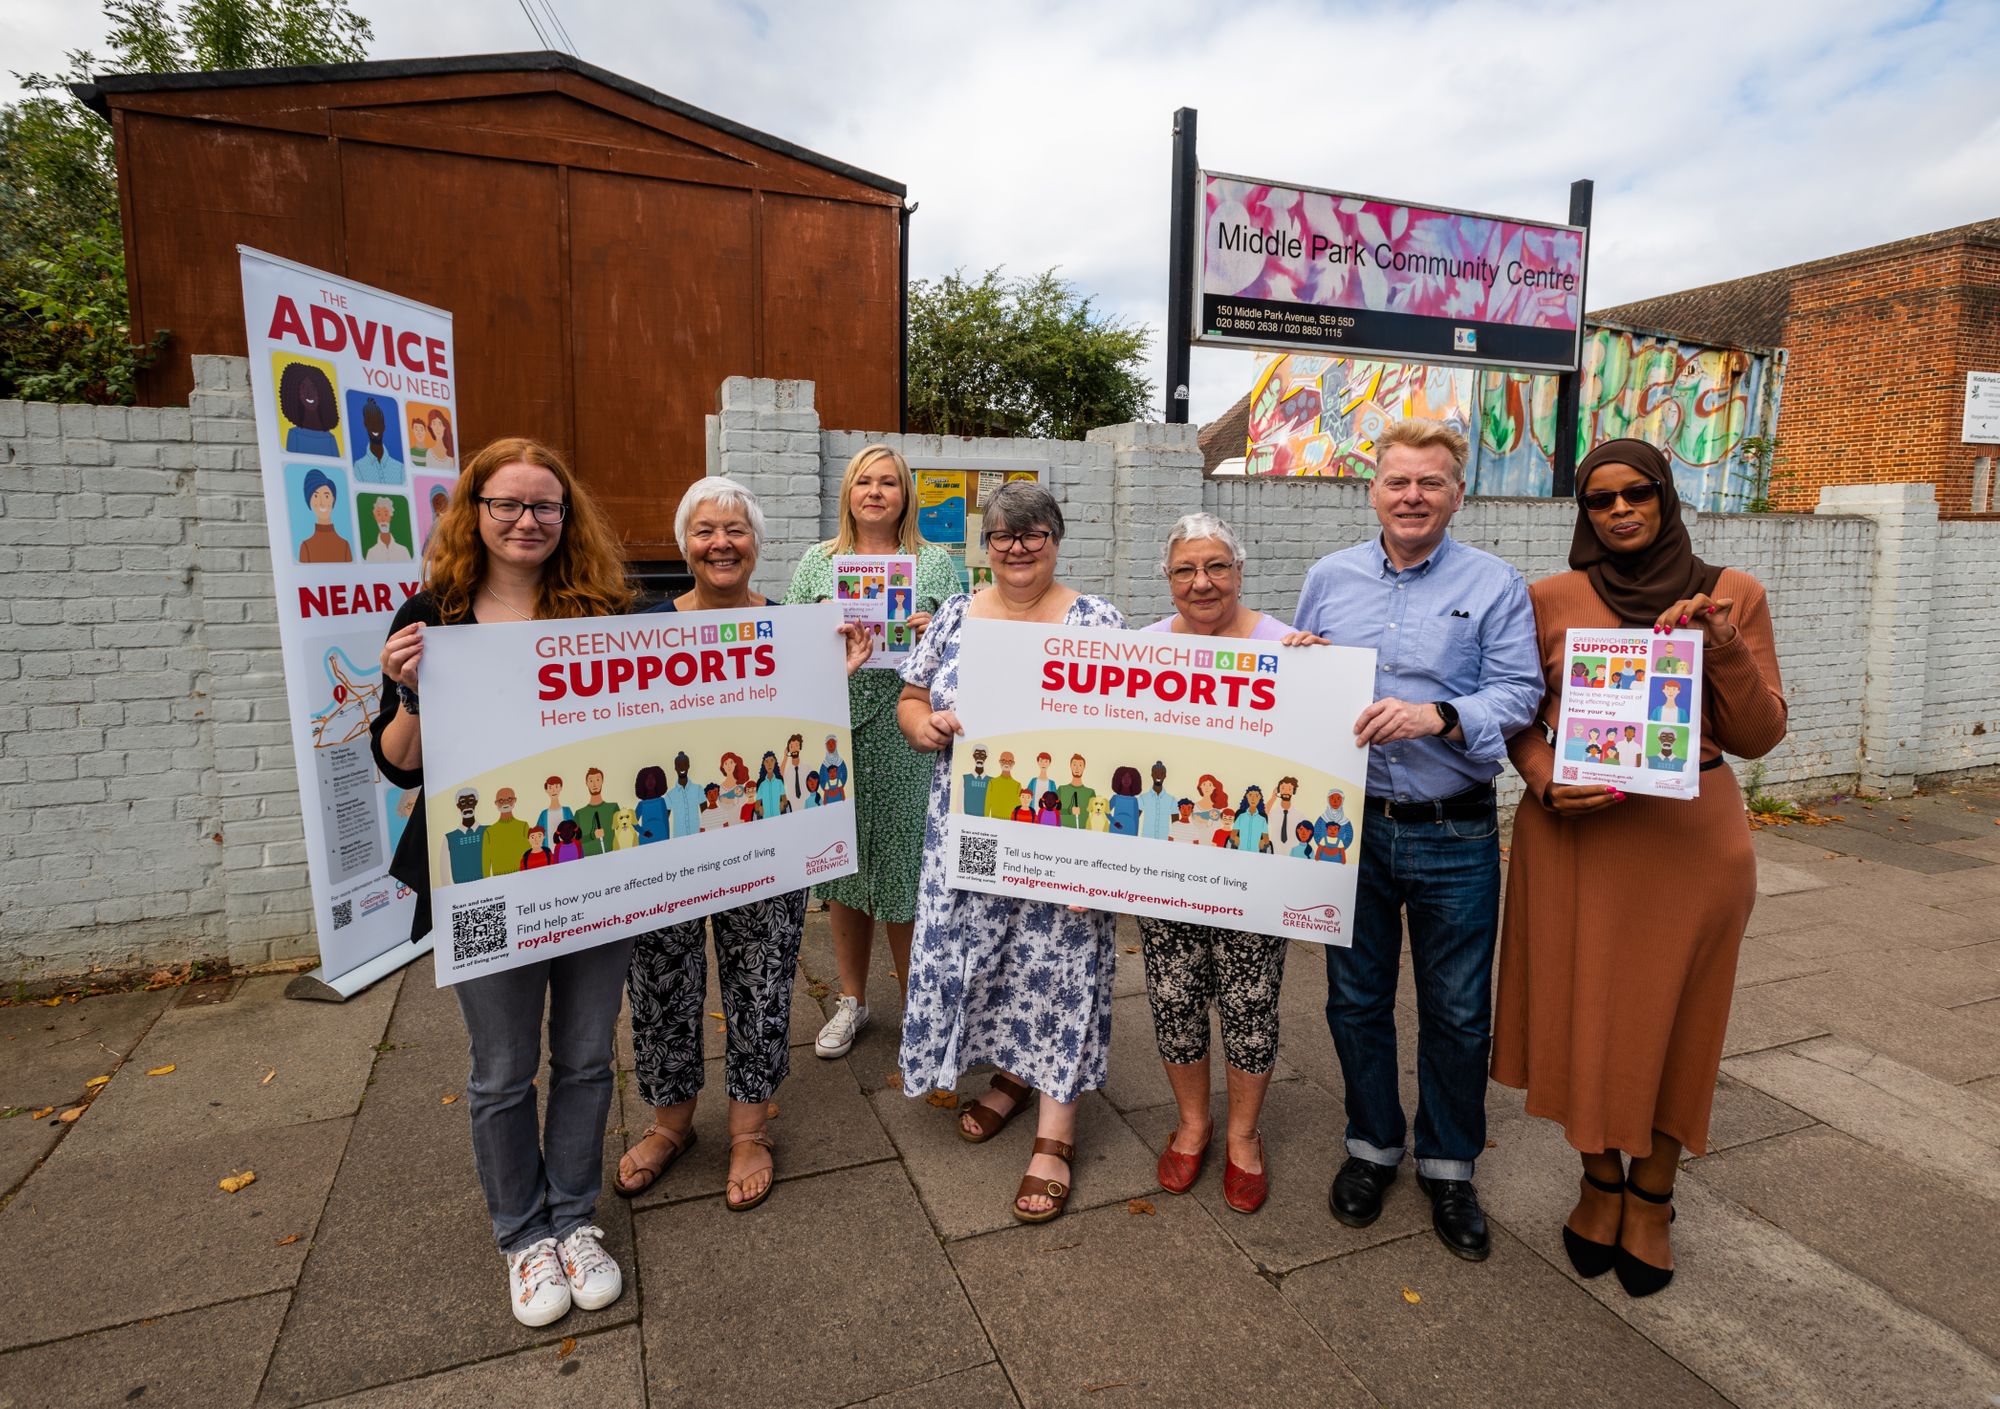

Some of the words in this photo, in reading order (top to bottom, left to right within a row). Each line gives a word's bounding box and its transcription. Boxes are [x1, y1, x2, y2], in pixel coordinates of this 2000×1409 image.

[1218, 222, 1302, 259] Middle
[1311, 235, 1365, 267] Park
[1374, 243, 1500, 288] Community
[1506, 260, 1575, 292] Centre
[320, 289, 348, 310] THE
[1215, 317, 1233, 329] 020
[1234, 318, 1256, 330] 8850
[1257, 320, 1278, 332] 2638
[1284, 322, 1301, 334] 020
[1302, 323, 1323, 335] 8850
[1324, 326, 1342, 338] 1115
[1216, 305, 1233, 317] 150
[1234, 306, 1263, 320] Middle
[1264, 309, 1284, 321] Park
[1284, 312, 1317, 325] Avenue,
[1319, 315, 1336, 326] SE9
[1337, 316, 1356, 328] 5SD
[268, 294, 449, 379] ADVICE
[362, 366, 402, 391] YOU
[406, 376, 451, 401] NEED
[298, 583, 394, 618] NEAR
[535, 627, 697, 659] GREENWICH
[1044, 638, 1191, 667] GREENWICH
[1573, 636, 1621, 644] GREENWICH
[1573, 643, 1648, 655] SUPPORTS
[538, 644, 776, 701] SUPPORTS
[1041, 660, 1276, 711] SUPPORTS
[541, 709, 586, 727] Here
[593, 707, 611, 720] to
[617, 701, 664, 718] listen,
[670, 694, 715, 711] advise
[720, 687, 744, 704] and
[750, 684, 777, 702] help
[1585, 699, 1610, 707] affecting
[1041, 697, 1078, 714] Here
[1083, 704, 1099, 716] to
[1105, 703, 1148, 723] listen,
[1154, 709, 1200, 726] advise
[1207, 715, 1234, 729] and
[1241, 716, 1273, 737] help
[806, 857, 829, 869] ROYAL
[806, 858, 850, 876] GREENWICH
[1003, 862, 1021, 873] Find
[1023, 864, 1043, 877] help
[1044, 869, 1056, 878] at:
[1004, 846, 1020, 857] Tell
[1021, 851, 1031, 859] us
[1033, 851, 1053, 862] how
[1055, 856, 1072, 865] you
[1074, 858, 1089, 867] are
[1091, 859, 1127, 872] affected
[1130, 864, 1141, 875] by
[1143, 866, 1158, 876] the
[1161, 868, 1185, 882] rising
[1187, 873, 1208, 883] cost
[1210, 875, 1222, 885] of
[1223, 876, 1248, 891] living
[516, 902, 536, 916] Tell
[539, 901, 552, 911] us
[555, 895, 579, 907] how
[581, 890, 602, 904] you
[604, 885, 621, 896] are
[624, 873, 663, 891] affected
[666, 871, 677, 882] by
[680, 867, 695, 878] the
[697, 860, 721, 873] rising
[722, 855, 741, 867] cost
[742, 851, 753, 862] of
[754, 846, 776, 859] living
[452, 903, 467, 911] Scan
[468, 899, 479, 907] and
[1002, 875, 1244, 917] royalgreenwich.gov.uk/greenwich-supports
[517, 874, 775, 950] royalgreenwich.gov.uk/greenwich-supports
[517, 920, 541, 935] Find
[544, 915, 568, 929] help
[571, 911, 585, 922] at:
[1283, 911, 1312, 922] ROYAL
[1282, 918, 1341, 934] GREENWICH
[452, 962, 466, 970] cost
[467, 959, 474, 967] of
[474, 956, 490, 965] living
[491, 952, 510, 961] survey
